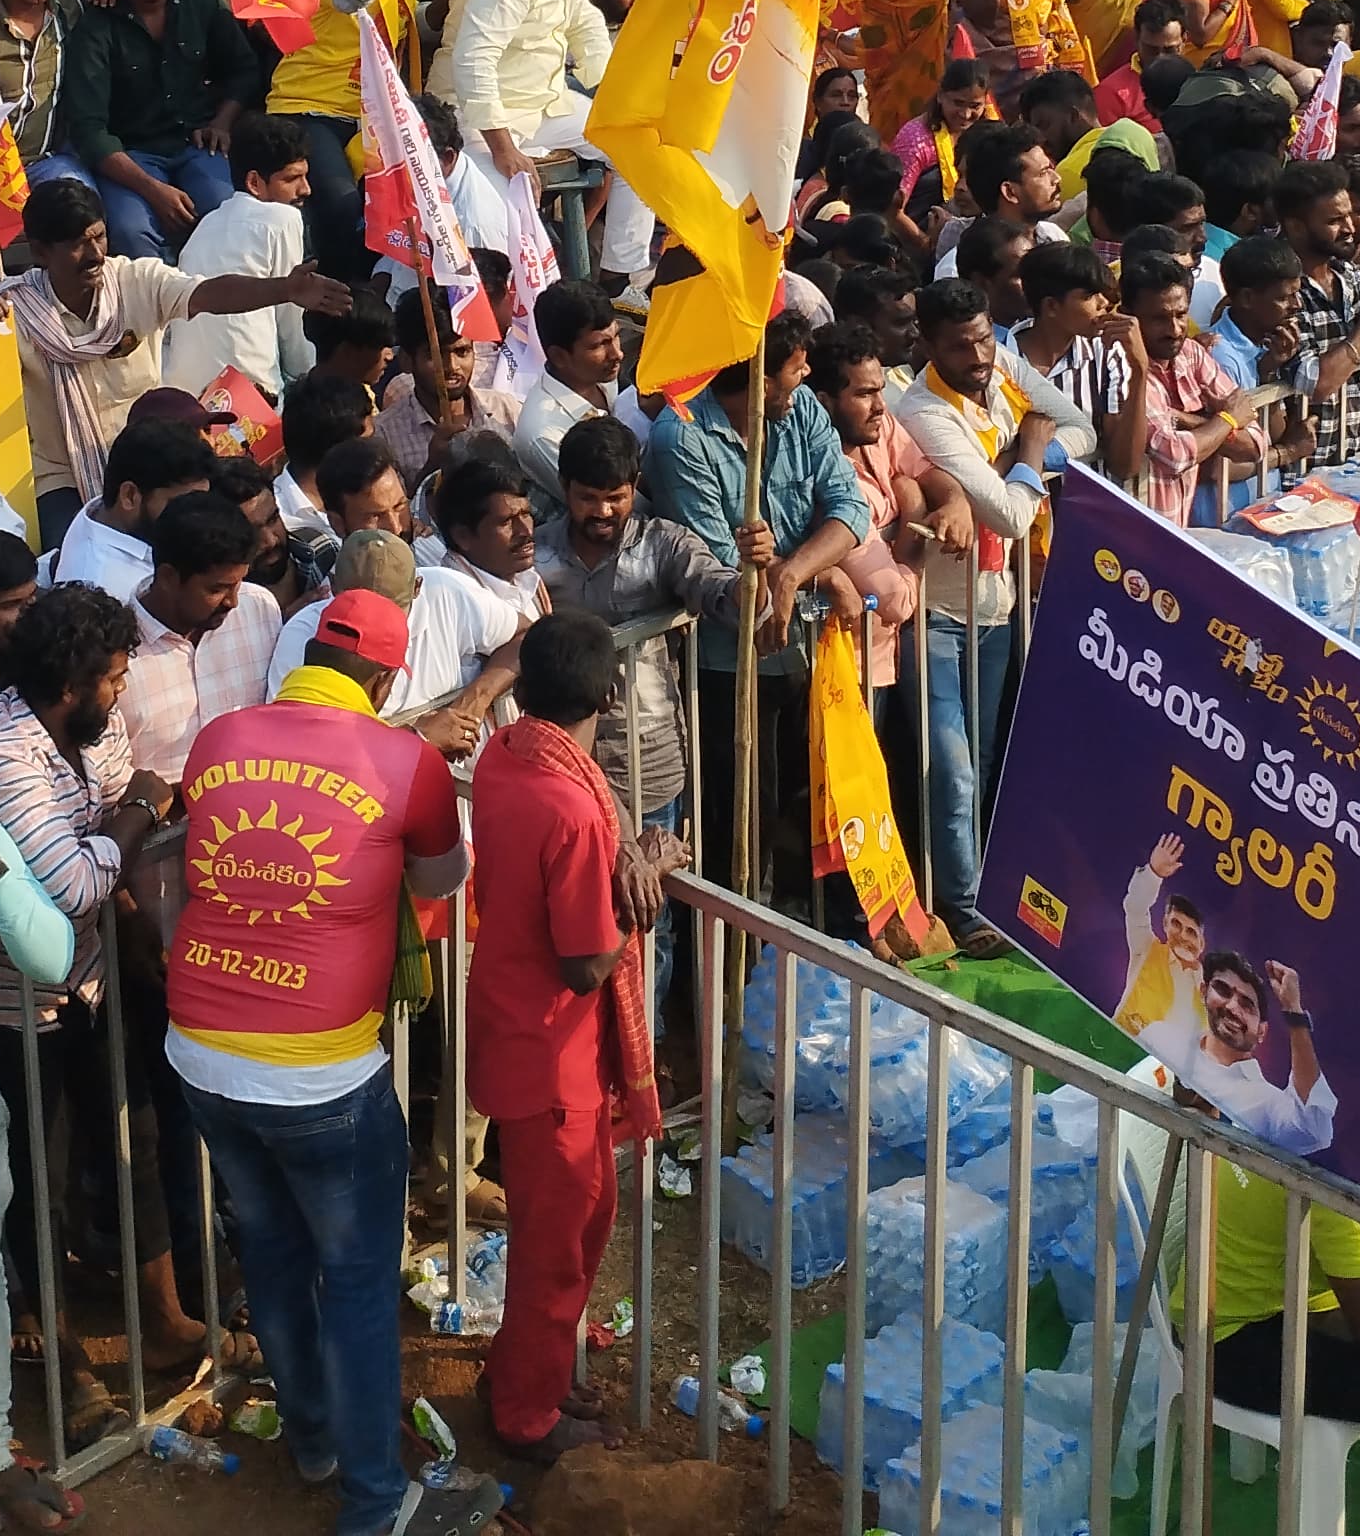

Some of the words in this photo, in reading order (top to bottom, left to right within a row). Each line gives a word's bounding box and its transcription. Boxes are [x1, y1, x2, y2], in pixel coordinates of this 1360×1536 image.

[1077, 607, 1246, 762] మీడియా
[187, 759, 385, 825] VOLUNTEER
[214, 853, 313, 888] నవశకం
[1165, 765, 1339, 923] గ్యాలరీ
[183, 939, 309, 991] 20-12-2023
